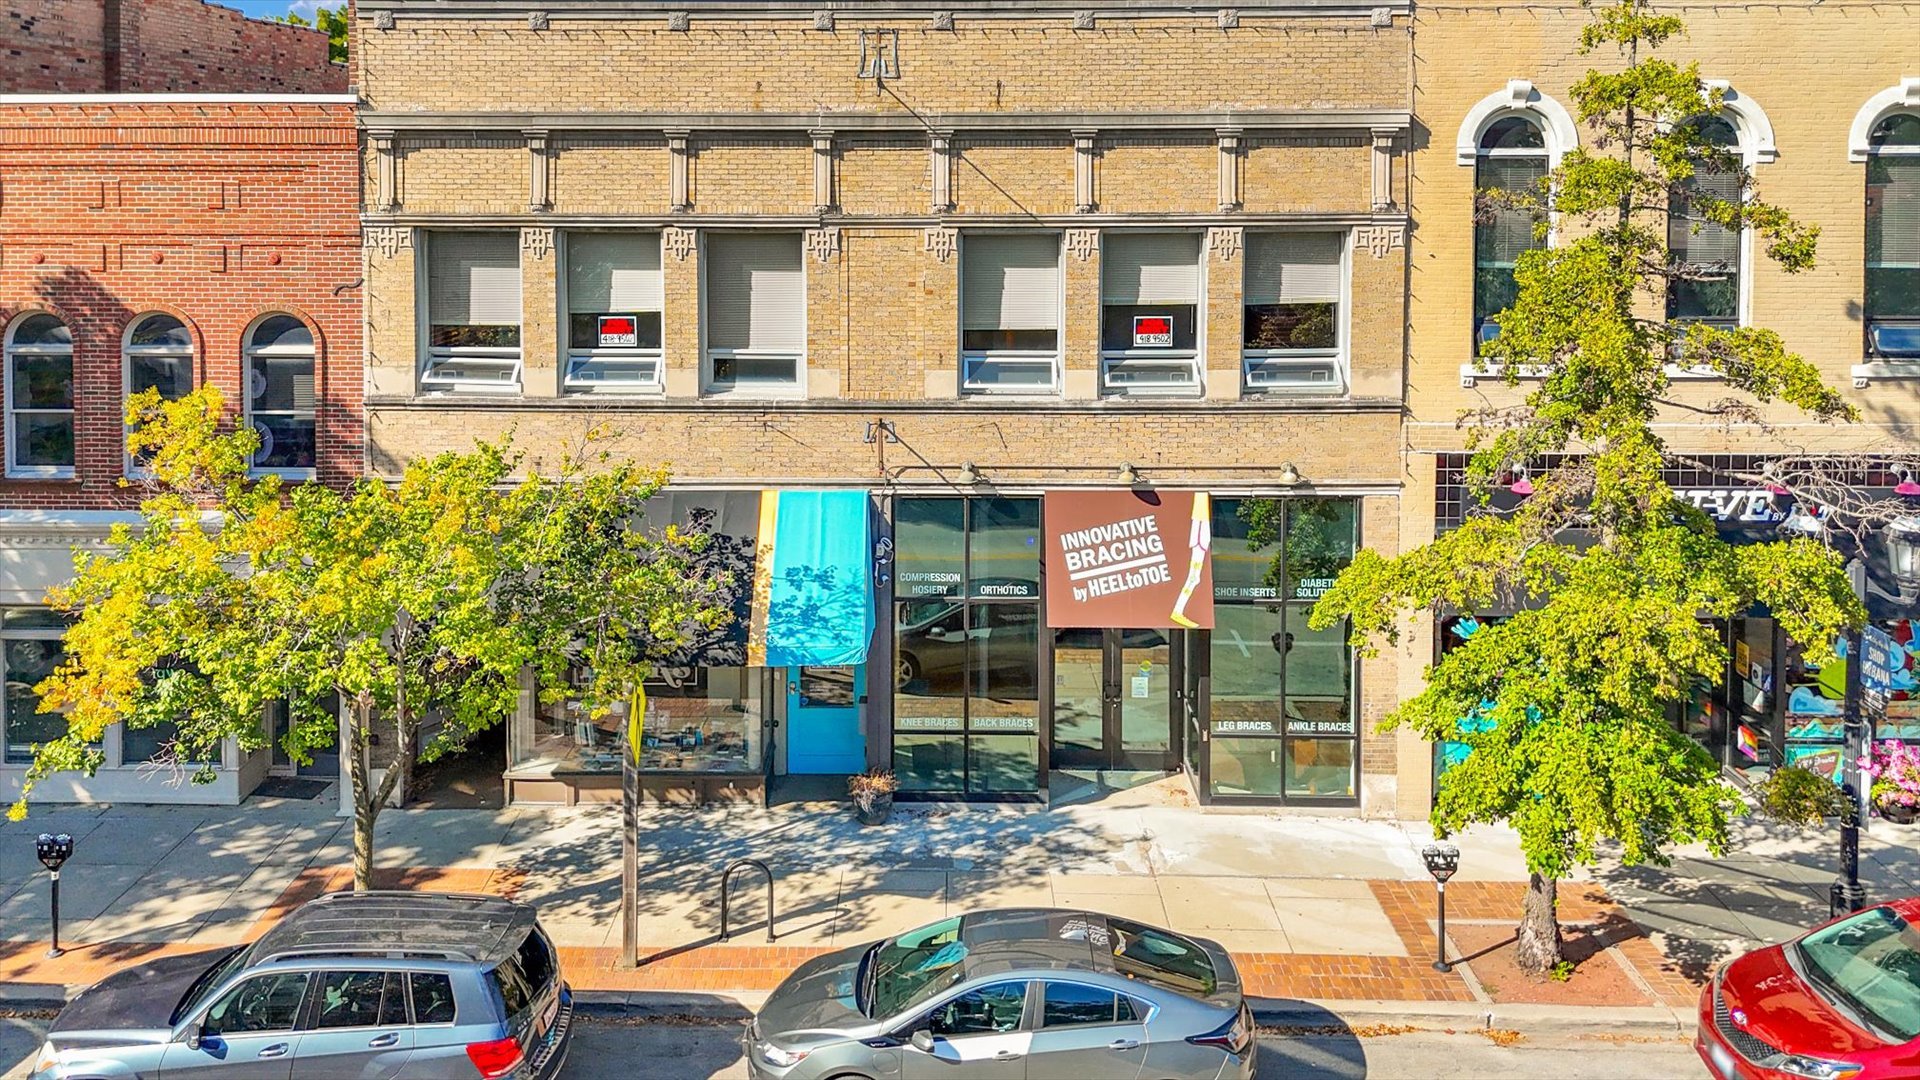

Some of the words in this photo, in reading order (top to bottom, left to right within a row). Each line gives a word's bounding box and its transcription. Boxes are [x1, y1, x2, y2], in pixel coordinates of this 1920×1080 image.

[1060, 515, 1158, 551] INNOVATIVE
[1065, 534, 1164, 571] BRACING
[899, 572, 961, 582] COMPRESSION
[1073, 586, 1088, 603] by
[1087, 564, 1172, 597] HEELtoTOE
[1300, 578, 1336, 588] DIABETI
[912, 585, 948, 595] HOSIERY
[980, 585, 1028, 595] ORTHOTICS
[1214, 587, 1237, 597] SHOE
[1240, 588, 1277, 597] INSERTS
[1868, 646, 1885, 666] SHOP
[1862, 660, 1891, 686] URBANA
[901, 718, 923, 727] KNEE
[924, 718, 959, 727] BRACES
[974, 718, 998, 728] BACK
[1000, 718, 1034, 728] BRACES
[1218, 721, 1236, 730] LEG
[1237, 721, 1272, 731] BRACES
[1287, 721, 1316, 731] ANKLE
[1318, 722, 1353, 732] BRACES
